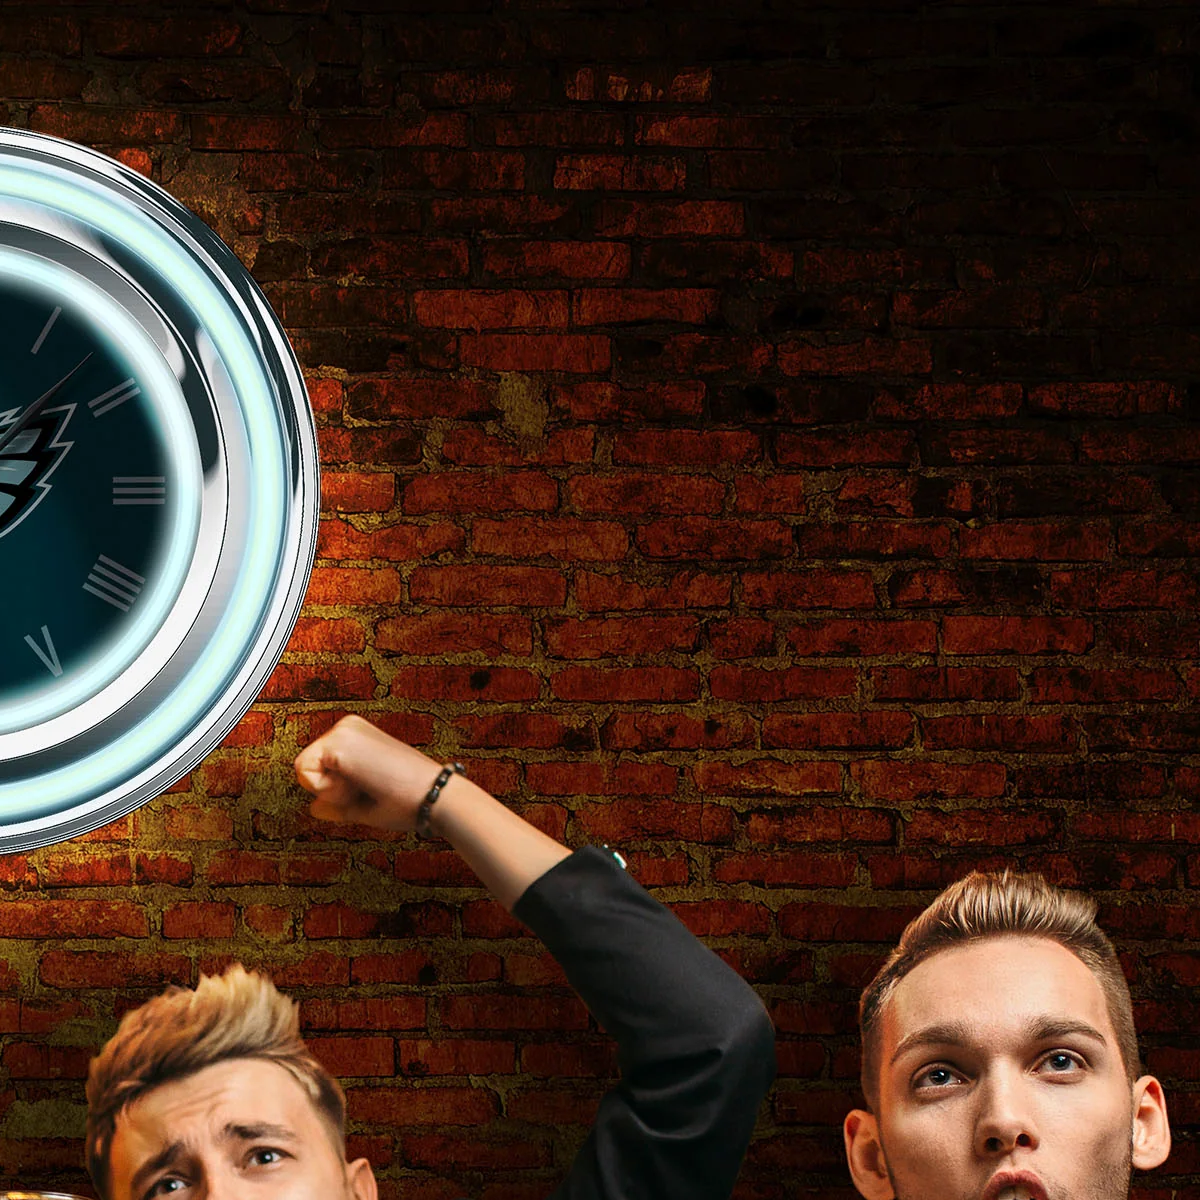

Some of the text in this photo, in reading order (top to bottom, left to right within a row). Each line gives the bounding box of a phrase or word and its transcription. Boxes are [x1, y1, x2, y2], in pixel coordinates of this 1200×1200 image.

[88, 377, 141, 418] II
[112, 476, 166, 504] III
[82, 554, 146, 613] IIII
[24, 624, 63, 678] V
